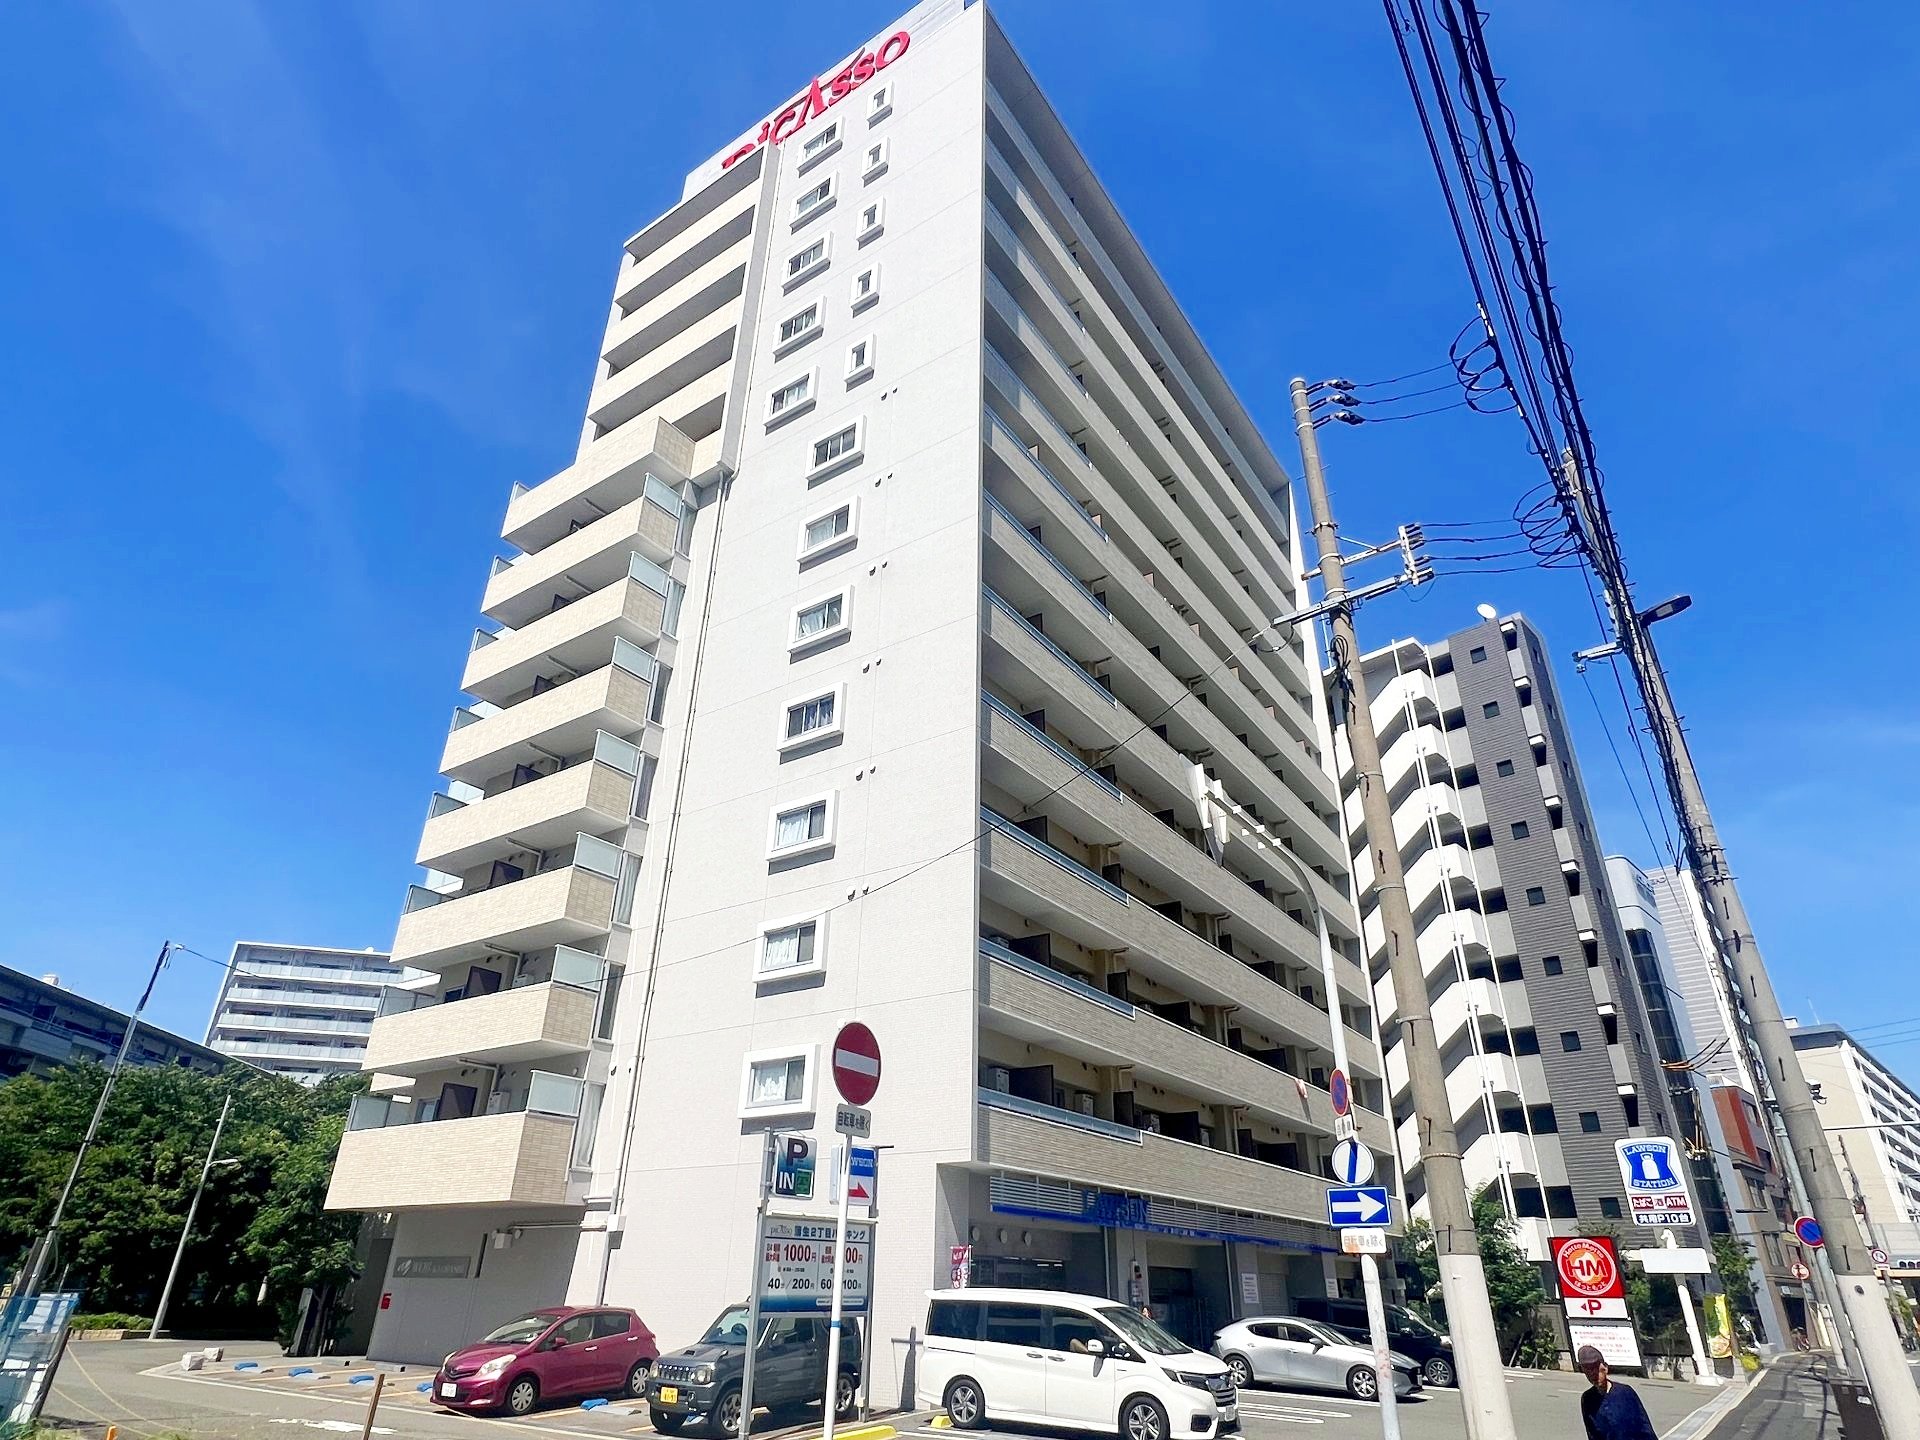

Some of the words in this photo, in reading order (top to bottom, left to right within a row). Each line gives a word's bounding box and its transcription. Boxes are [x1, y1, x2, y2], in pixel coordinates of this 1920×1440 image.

[787, 1137, 809, 1166] P
[1624, 1144, 1667, 1155] LAWSON
[778, 1171, 795, 1190] IN
[1633, 1177, 1675, 1188] STATION
[1666, 1196, 1687, 1207] ATM
[1566, 1259, 1609, 1278] HM
[1587, 1299, 1602, 1315] P
